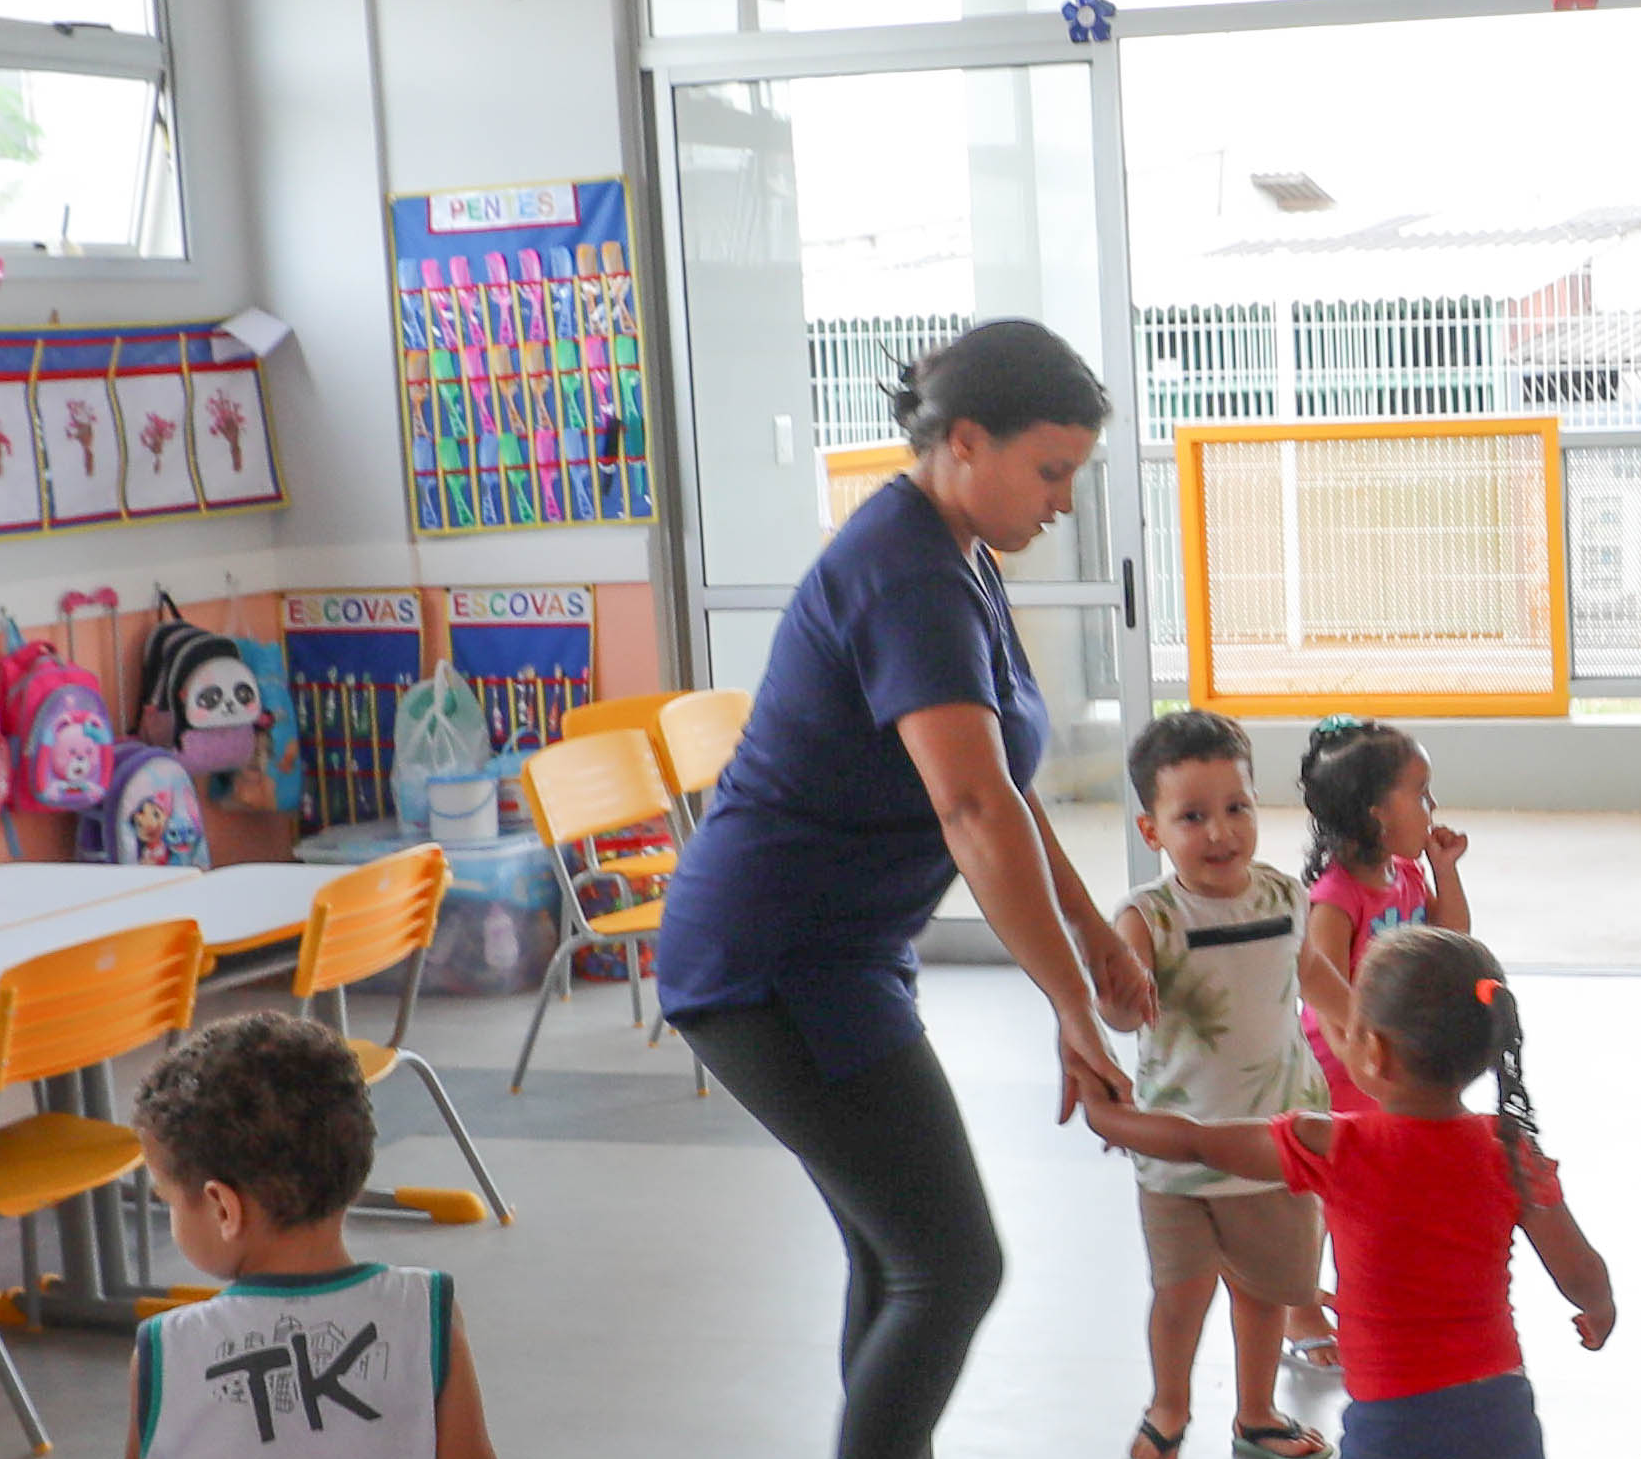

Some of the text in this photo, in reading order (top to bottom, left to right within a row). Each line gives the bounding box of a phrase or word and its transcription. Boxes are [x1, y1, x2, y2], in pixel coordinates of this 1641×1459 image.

[449, 190, 555, 221] PENTES
[288, 598, 414, 623] ESCOVAS
[453, 593, 584, 617] ESCOVAS
[205, 1321, 382, 1444] TK
